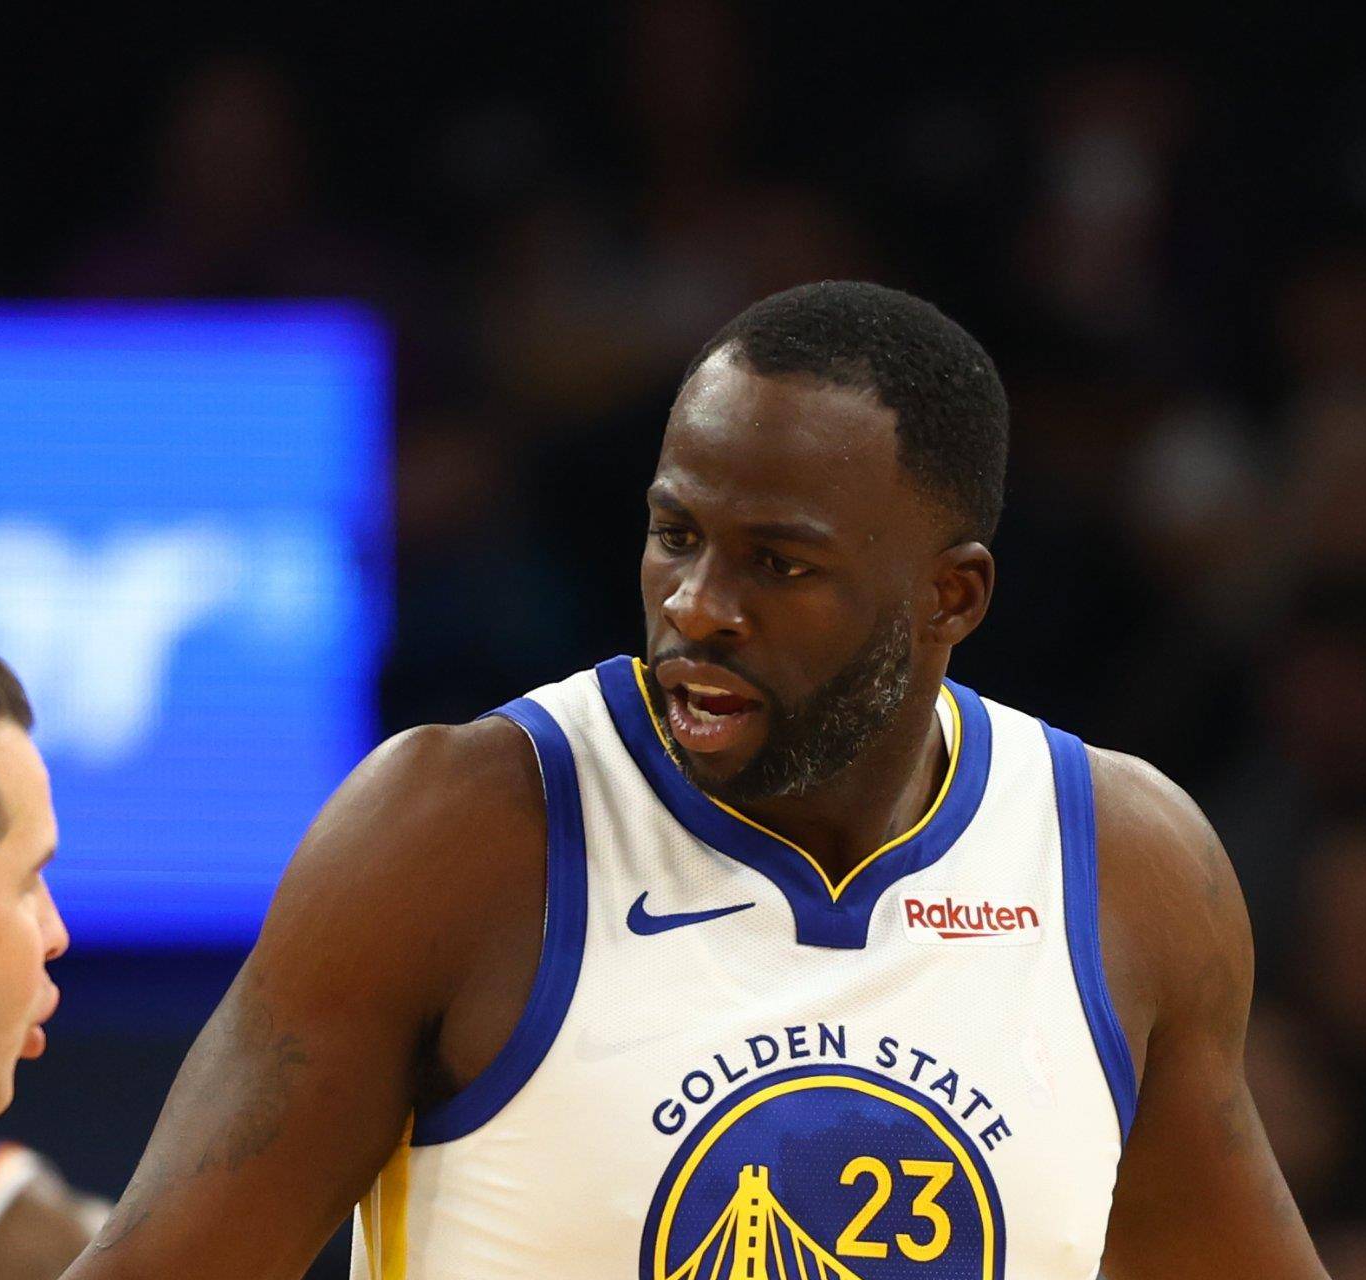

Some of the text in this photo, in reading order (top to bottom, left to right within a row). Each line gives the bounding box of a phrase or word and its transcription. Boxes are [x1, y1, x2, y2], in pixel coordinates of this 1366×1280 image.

[904, 897, 1040, 931] Rakuten
[651, 1022, 1013, 1151] GOLDEN STATE
[834, 1156, 955, 1262] 23
